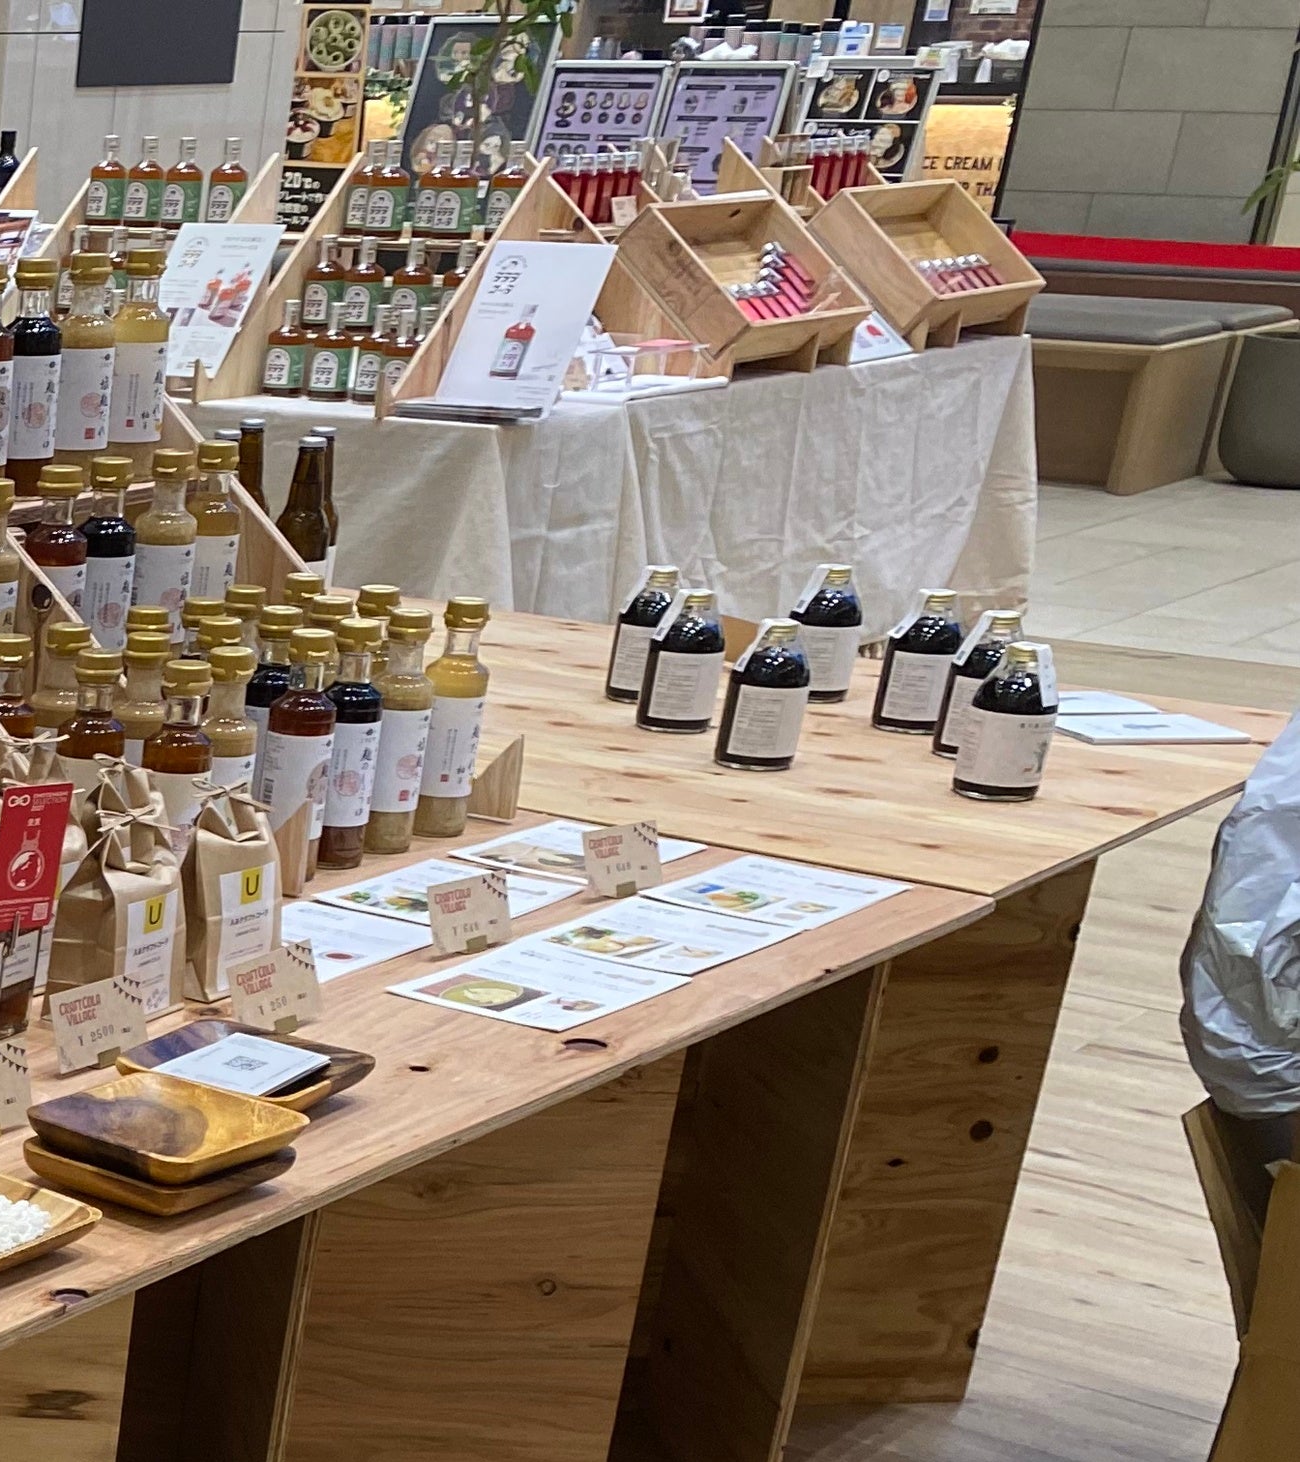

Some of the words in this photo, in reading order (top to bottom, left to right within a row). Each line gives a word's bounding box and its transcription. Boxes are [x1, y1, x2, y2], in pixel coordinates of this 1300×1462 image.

[944, 156, 994, 171] CREAM
[246, 874, 260, 896] U
[149, 902, 162, 925] U
[82, 993, 101, 1009] COLA
[65, 1008, 98, 1027] VILLAGE
